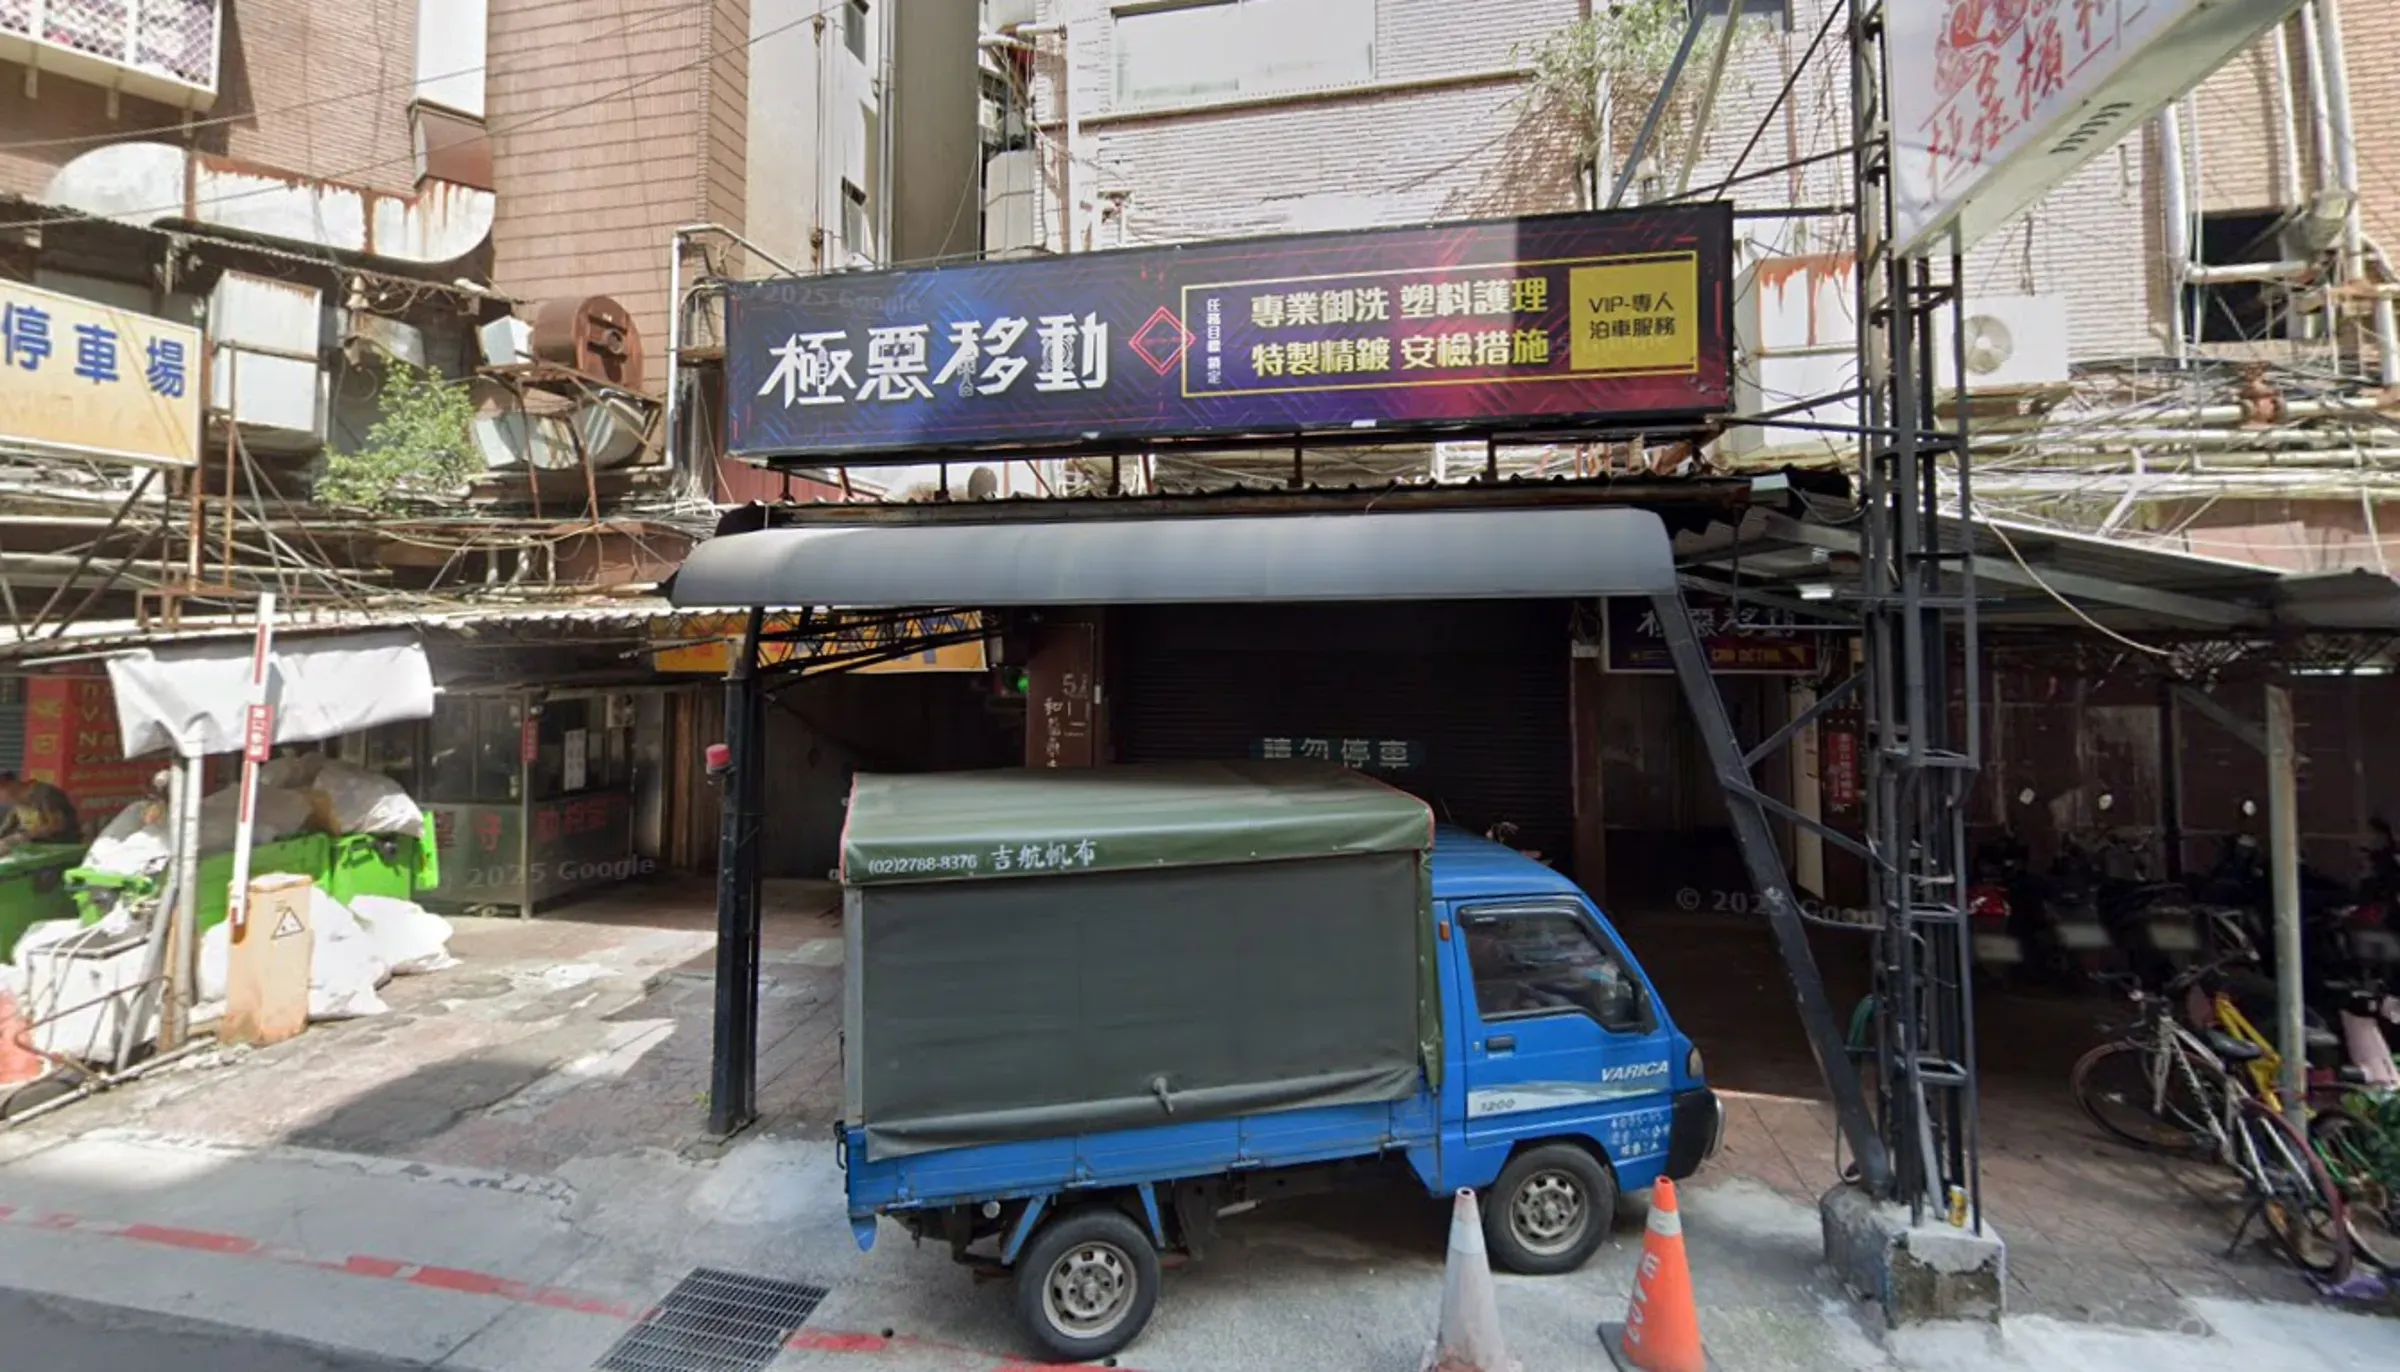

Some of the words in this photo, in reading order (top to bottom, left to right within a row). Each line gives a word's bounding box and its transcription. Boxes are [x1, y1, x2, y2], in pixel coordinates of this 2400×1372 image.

[1251, 286, 1390, 328] 專業御洗
[1400, 277, 1547, 319] 塑料護理
[1589, 317, 1676, 340] 泊車服務
[1, 301, 186, 398] 停車場
[1251, 336, 1391, 377] 特製精鍍
[1400, 329, 1549, 371] 安檢措施
[1263, 738, 1410, 769] 請勿停車
[991, 838, 1097, 870] 吉航帆布
[1602, 1060, 1668, 1082] VARICA
[1481, 1098, 1516, 1112] 1200
